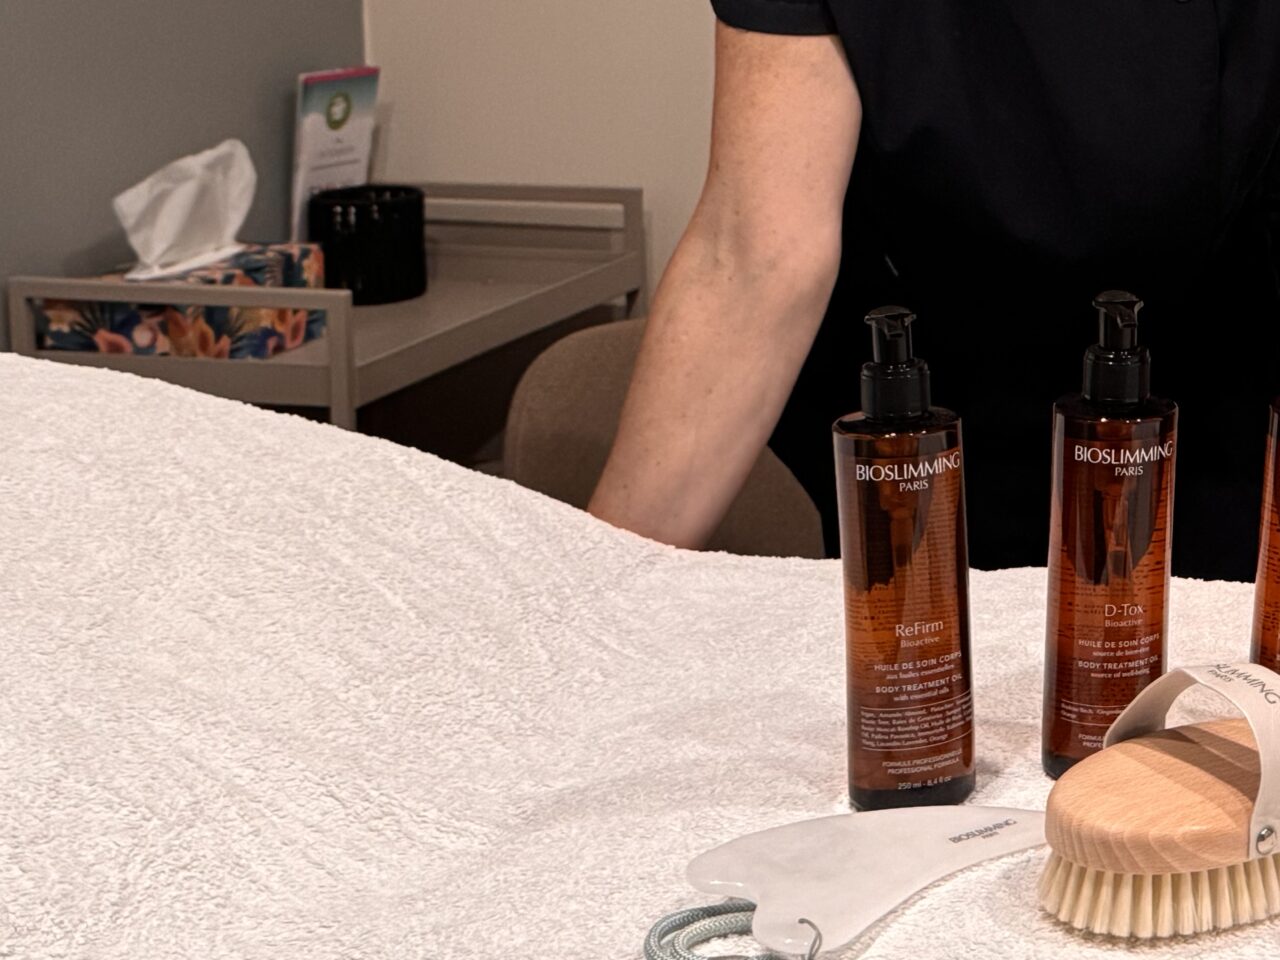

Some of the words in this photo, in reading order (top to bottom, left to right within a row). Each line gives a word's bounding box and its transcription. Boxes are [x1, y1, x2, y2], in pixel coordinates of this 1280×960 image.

[1074, 441, 1173, 465] BIOSLIMMING
[856, 451, 960, 481] BIOSLIMMING
[1114, 466, 1144, 476] PARIS
[899, 479, 929, 492] PARIS
[1104, 603, 1144, 617] D-Tox
[895, 620, 944, 637] ReFirm
[1104, 618, 1144, 628] Bioactive
[900, 636, 940, 648] Bioactive
[1078, 640, 1101, 648] HUILE
[1118, 639, 1138, 648] SOIN
[874, 663, 899, 671] HUILE
[902, 662, 915, 670] DE
[916, 658, 937, 668] SOIN
[1078, 660, 1100, 669] BODY
[1102, 658, 1149, 670] TREATMENT
[875, 686, 899, 694] BODY
[902, 677, 950, 692] TREATMENT
